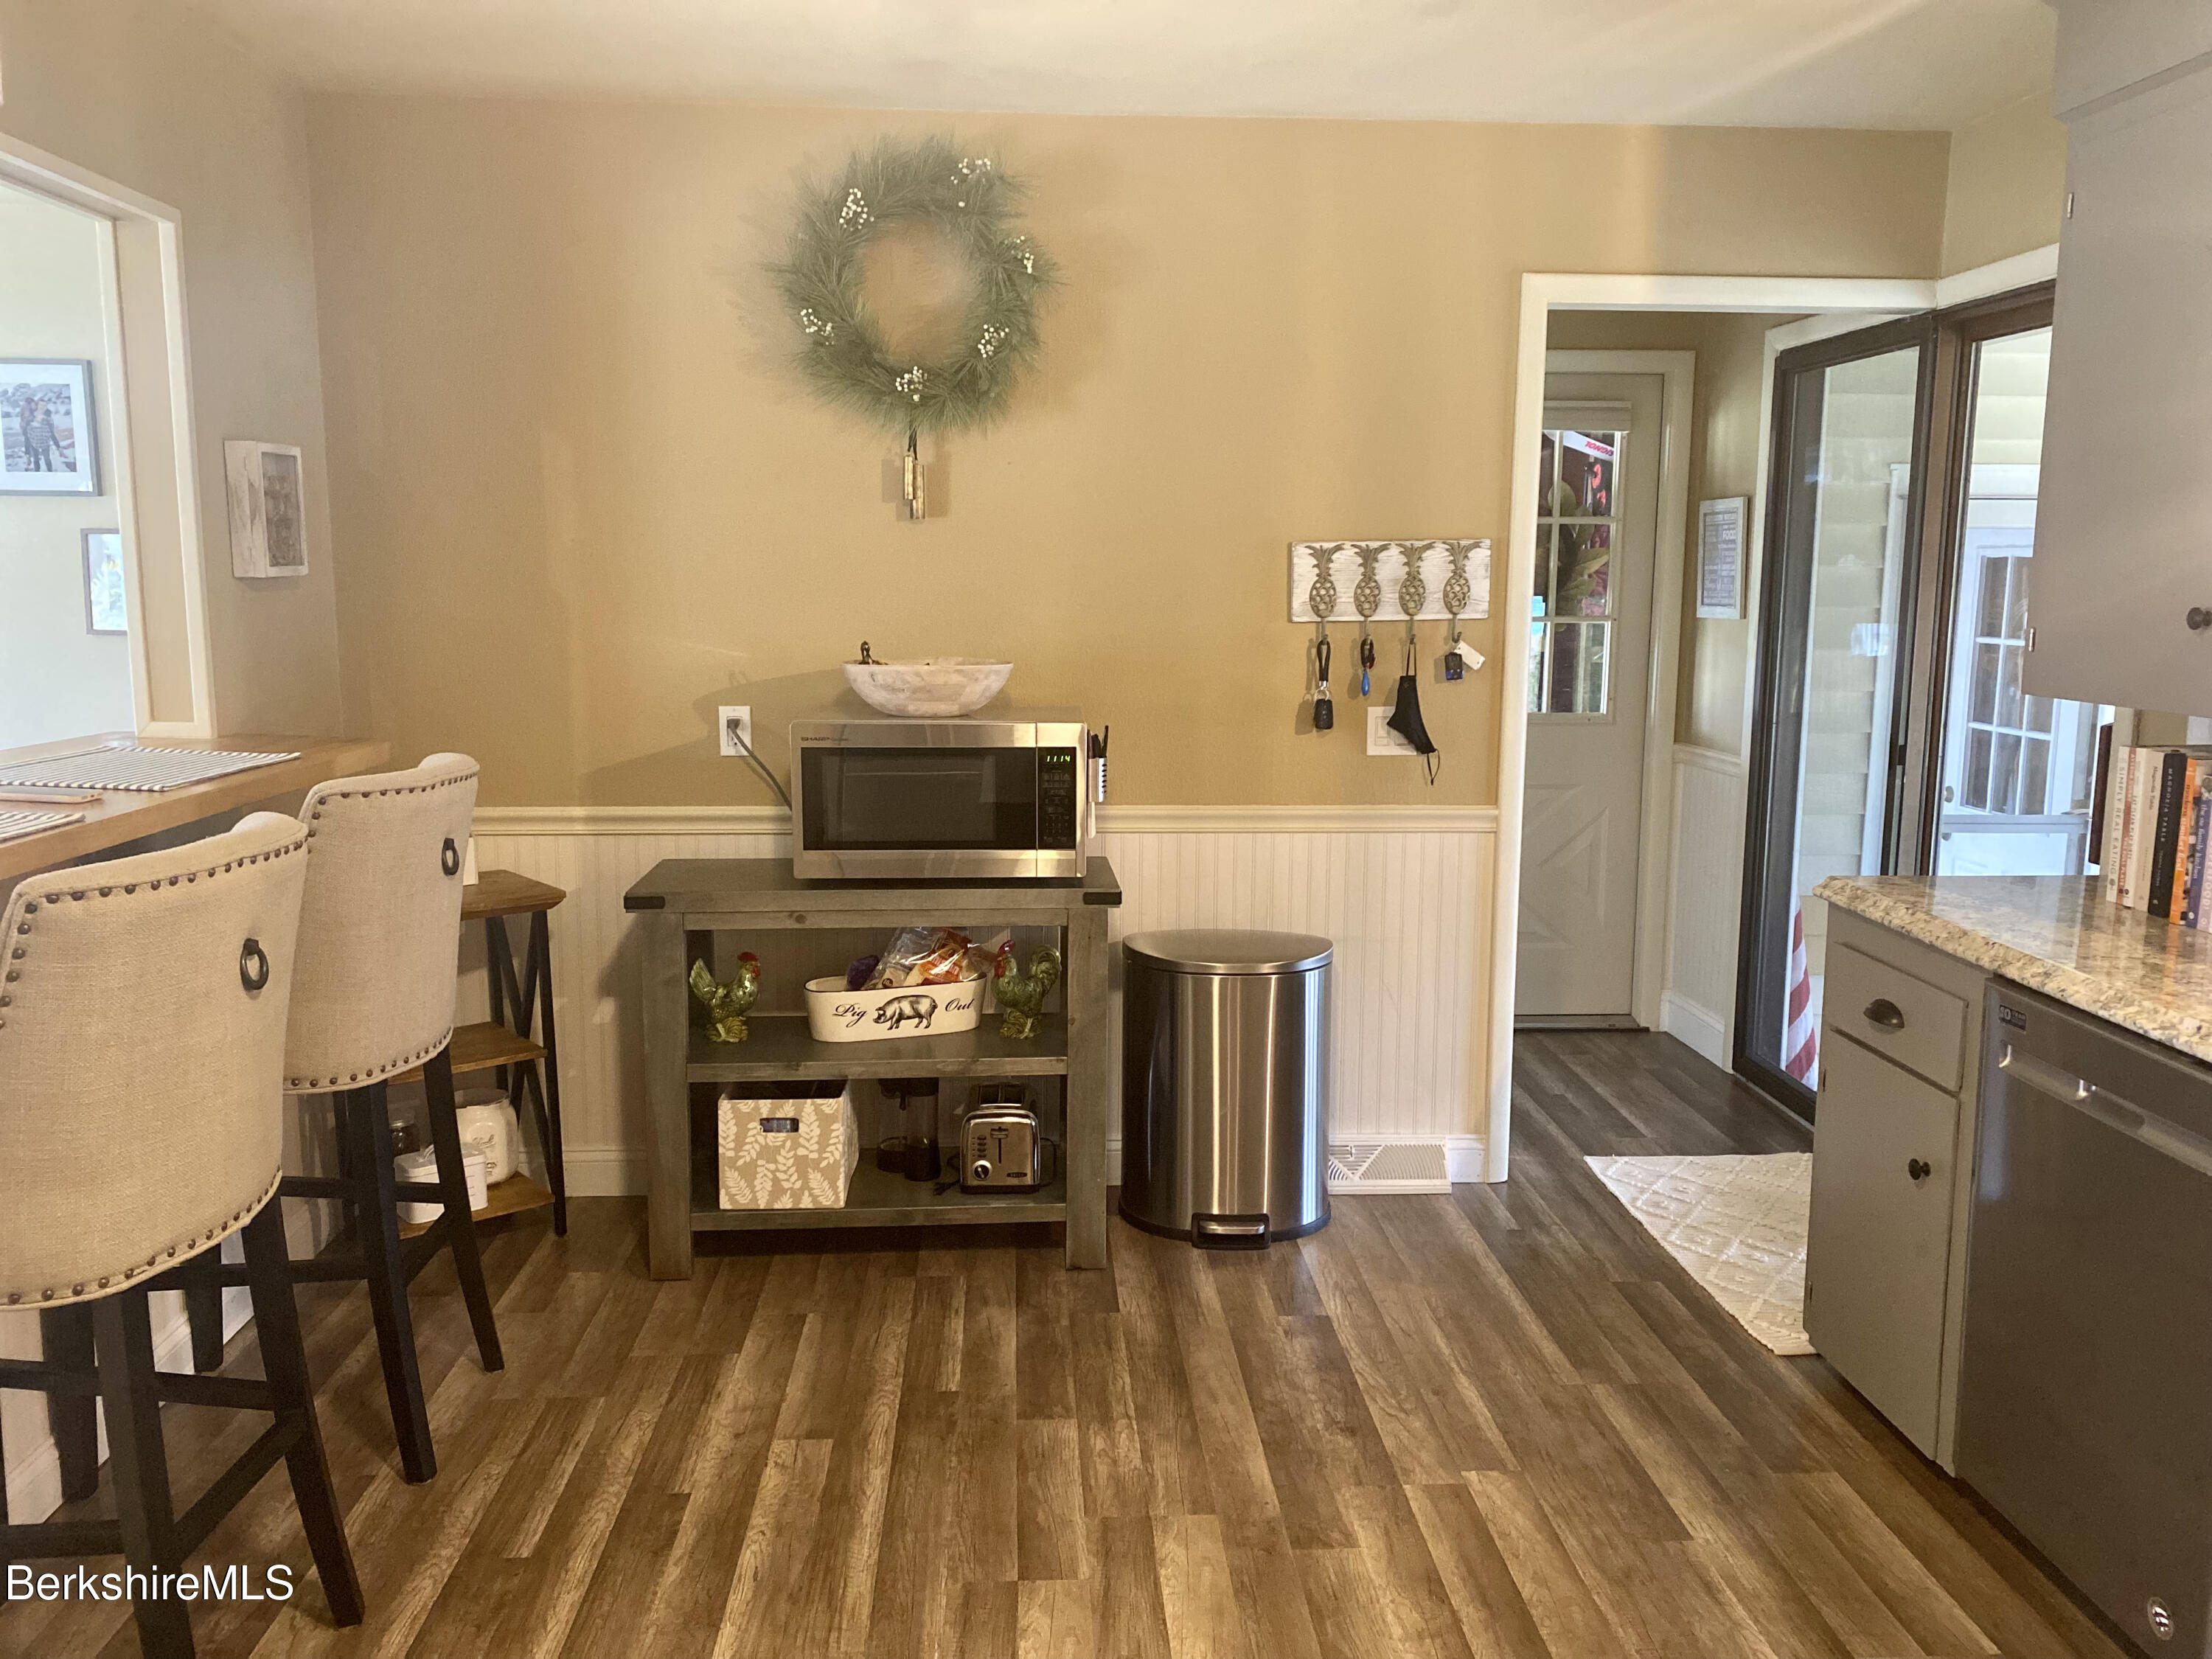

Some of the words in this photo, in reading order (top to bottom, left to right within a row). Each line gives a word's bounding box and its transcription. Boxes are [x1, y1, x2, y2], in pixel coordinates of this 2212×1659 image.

[2117, 767, 2125, 802] SIMPLY
[2163, 768, 2173, 812] MAGNOLIA
[2114, 808, 2122, 831] REAL
[2196, 827, 2205, 849] family
[2110, 838, 2119, 874] EATING
[2193, 852, 2202, 879] kitchen
[832, 1003, 867, 1028] Pig
[945, 998, 975, 1012] Out
